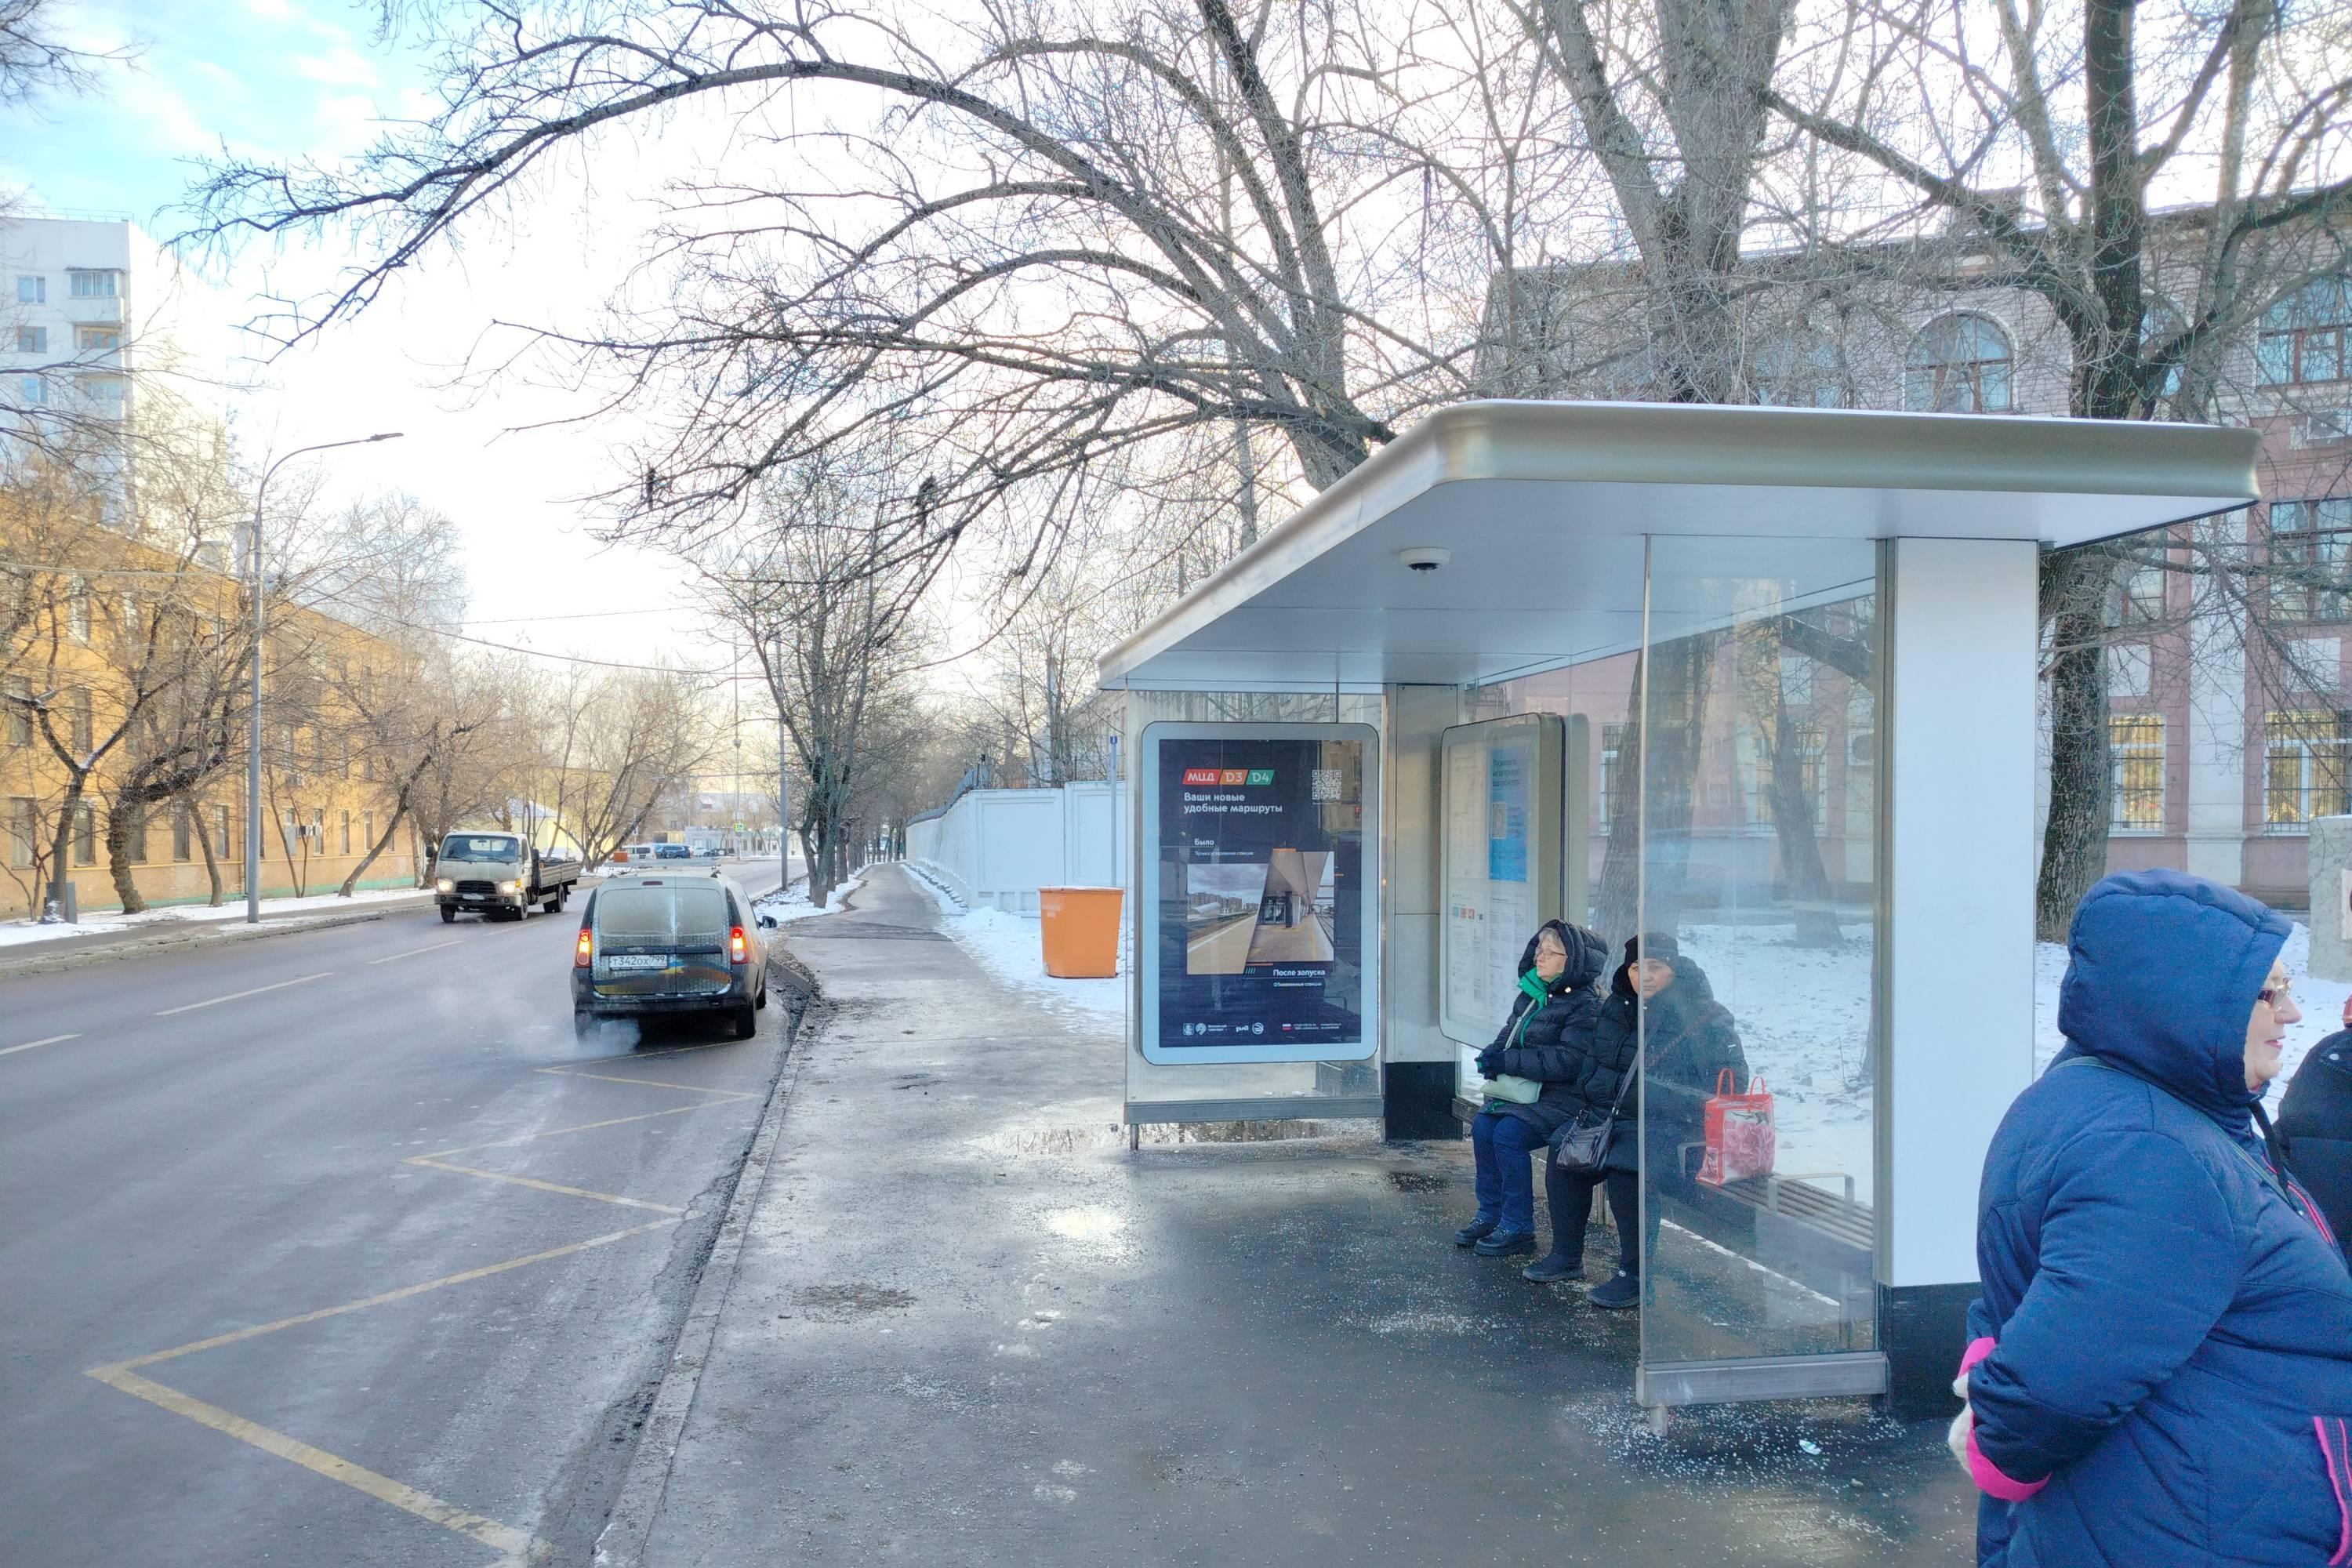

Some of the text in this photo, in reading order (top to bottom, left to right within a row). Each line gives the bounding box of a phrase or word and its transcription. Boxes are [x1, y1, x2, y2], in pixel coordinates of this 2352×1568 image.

[1187, 772, 1270, 782] МЦД D3 D4
[1184, 792, 1211, 801] Ваши
[1184, 804, 1283, 815] удобные маршруты
